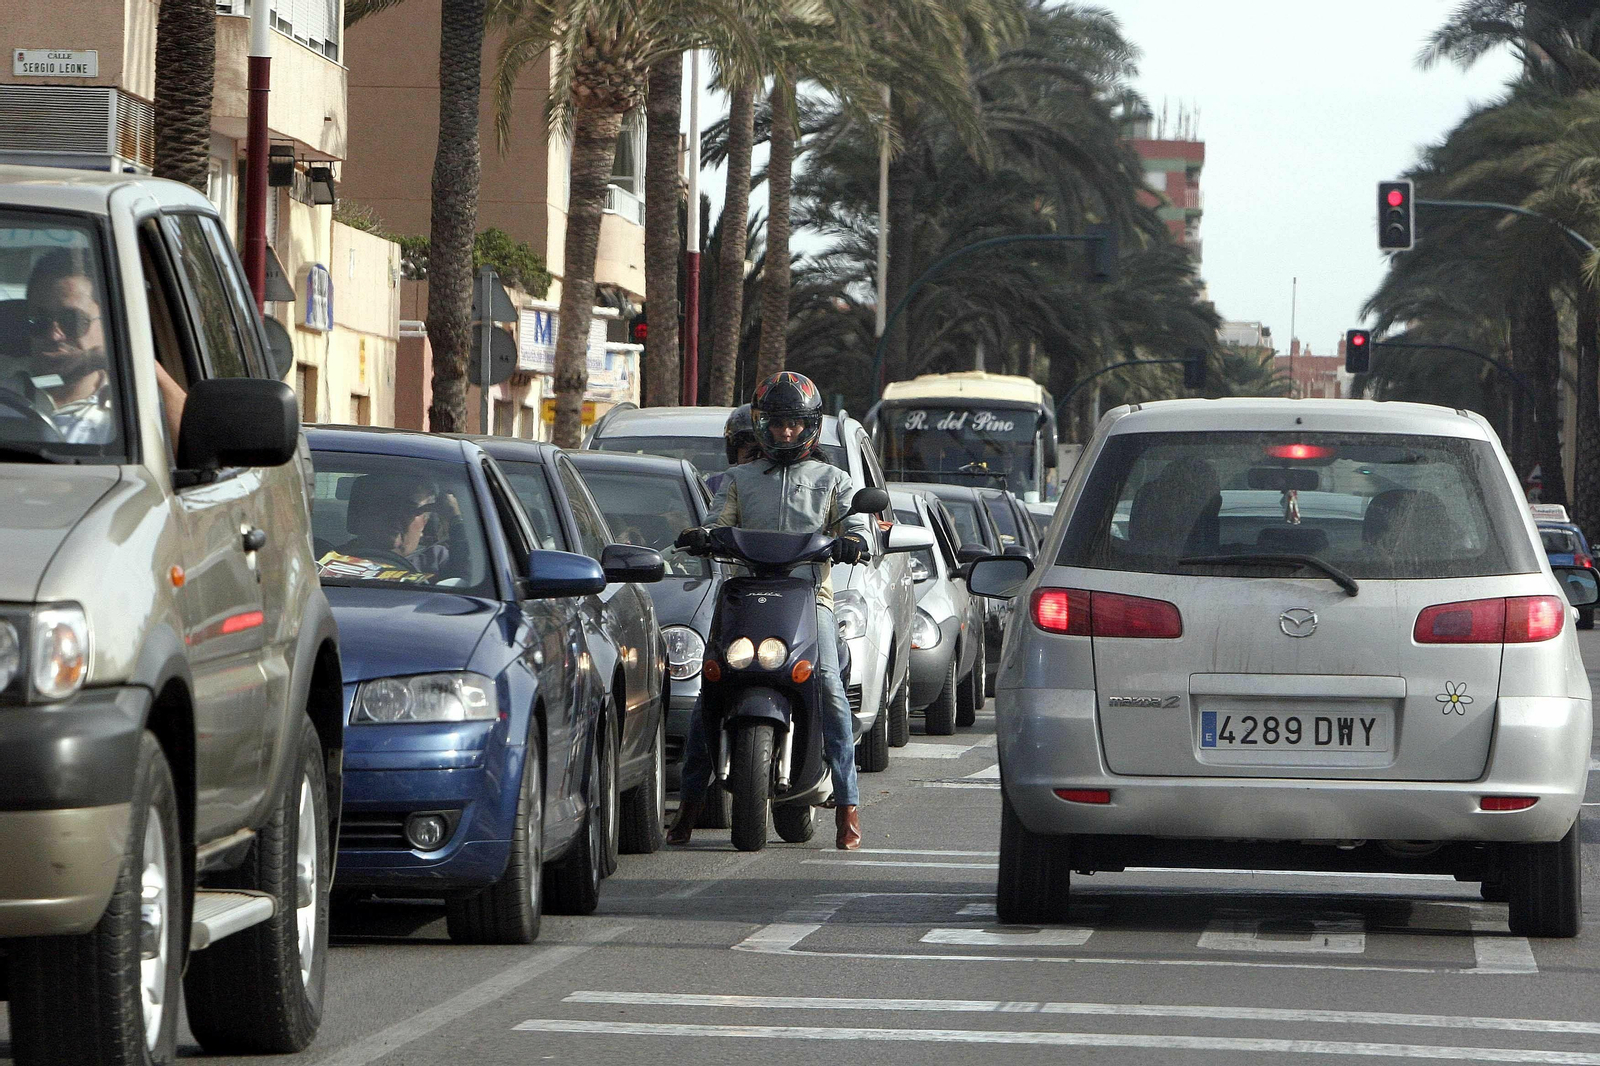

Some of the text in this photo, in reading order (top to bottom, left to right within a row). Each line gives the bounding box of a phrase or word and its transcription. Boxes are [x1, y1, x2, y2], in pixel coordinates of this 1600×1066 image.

[23, 62, 88, 74] SERGIO LEONE
[904, 410, 1015, 432] R. del Pino
[1205, 715, 1377, 747] E 4289 DWY
